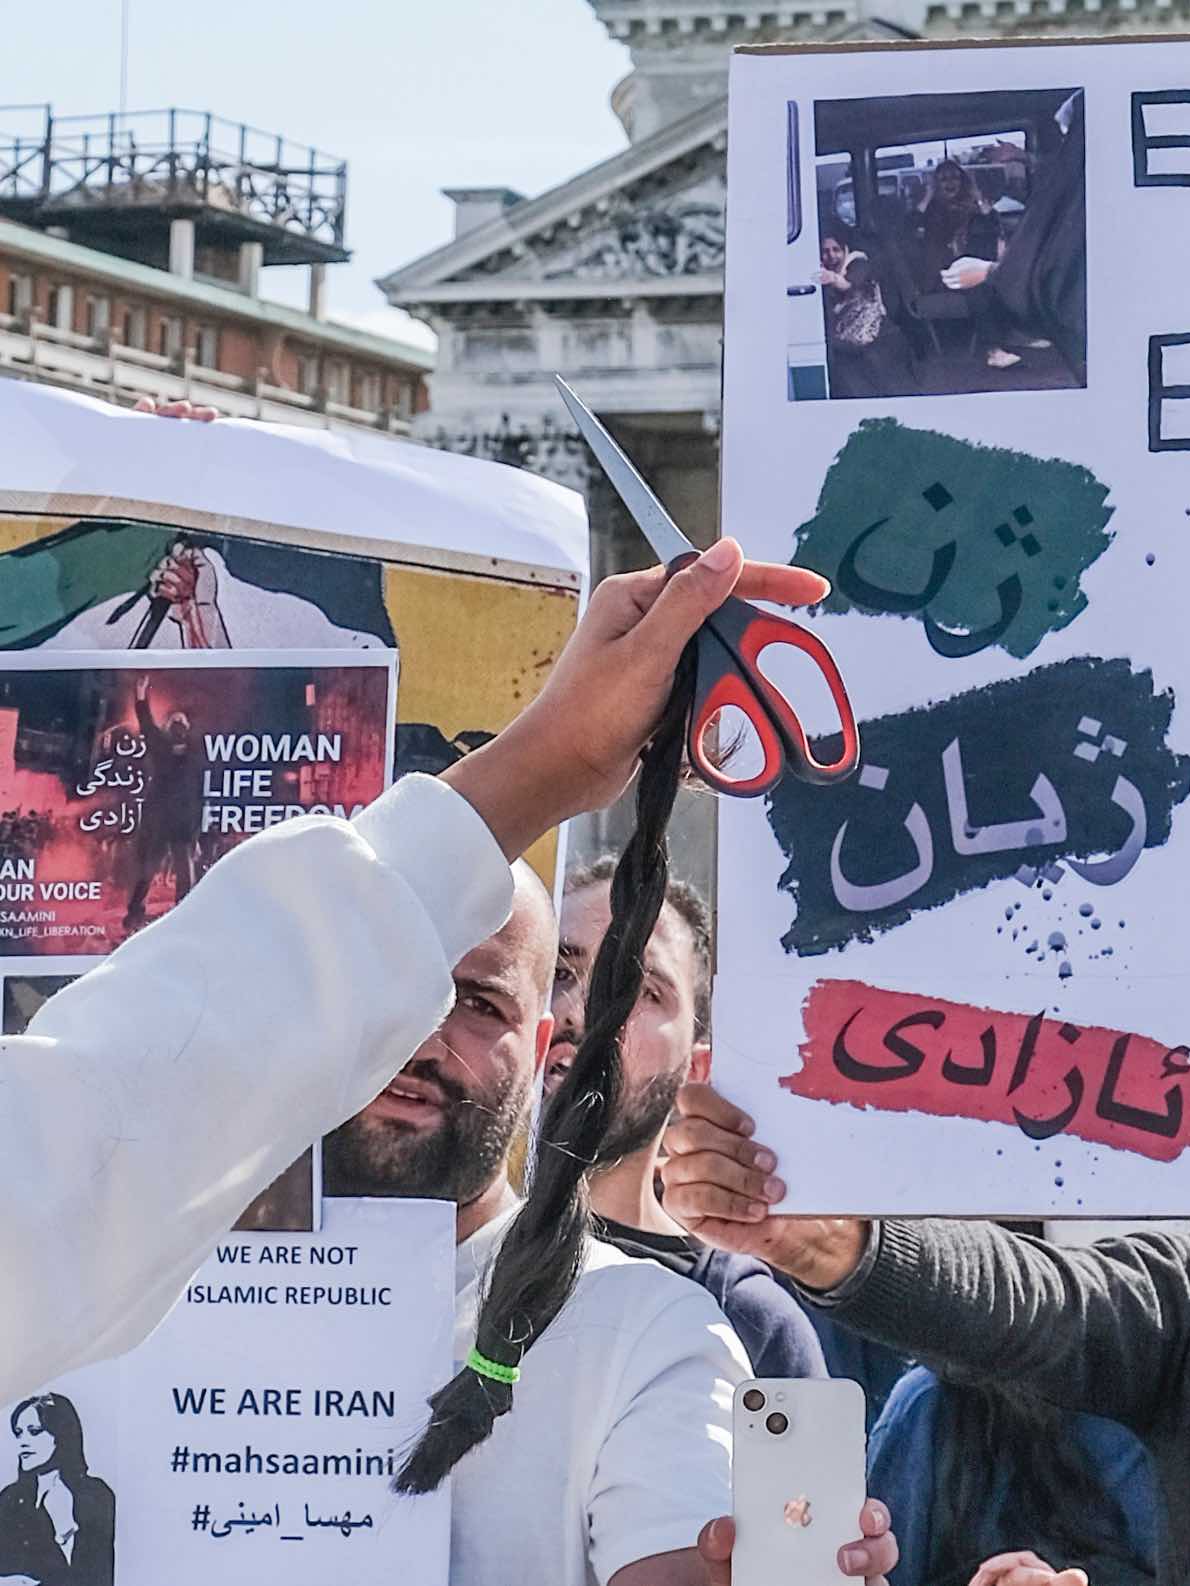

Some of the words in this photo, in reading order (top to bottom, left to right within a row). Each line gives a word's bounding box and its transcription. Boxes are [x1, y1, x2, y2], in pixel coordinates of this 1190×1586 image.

[836, 481, 1042, 659] ژن
[116, 734, 147, 758] زن
[203, 733, 342, 762] WOMAN
[76, 759, 145, 796] زندگی
[202, 769, 273, 798] LIFE
[80, 798, 145, 834] آزادی
[830, 715, 1148, 912] ژیان
[40, 881, 103, 901] VOICE
[216, 1245, 252, 1265] WE
[259, 1245, 302, 1265] ARE
[309, 1246, 359, 1266] NOT
[186, 1284, 278, 1305] ISLAMIC
[285, 1285, 393, 1306] REPUBLIC
[172, 1387, 227, 1415] WE
[236, 1388, 302, 1416] ARE
[314, 1389, 396, 1418] IRAN
[170, 1445, 395, 1476] #mahsaamini
